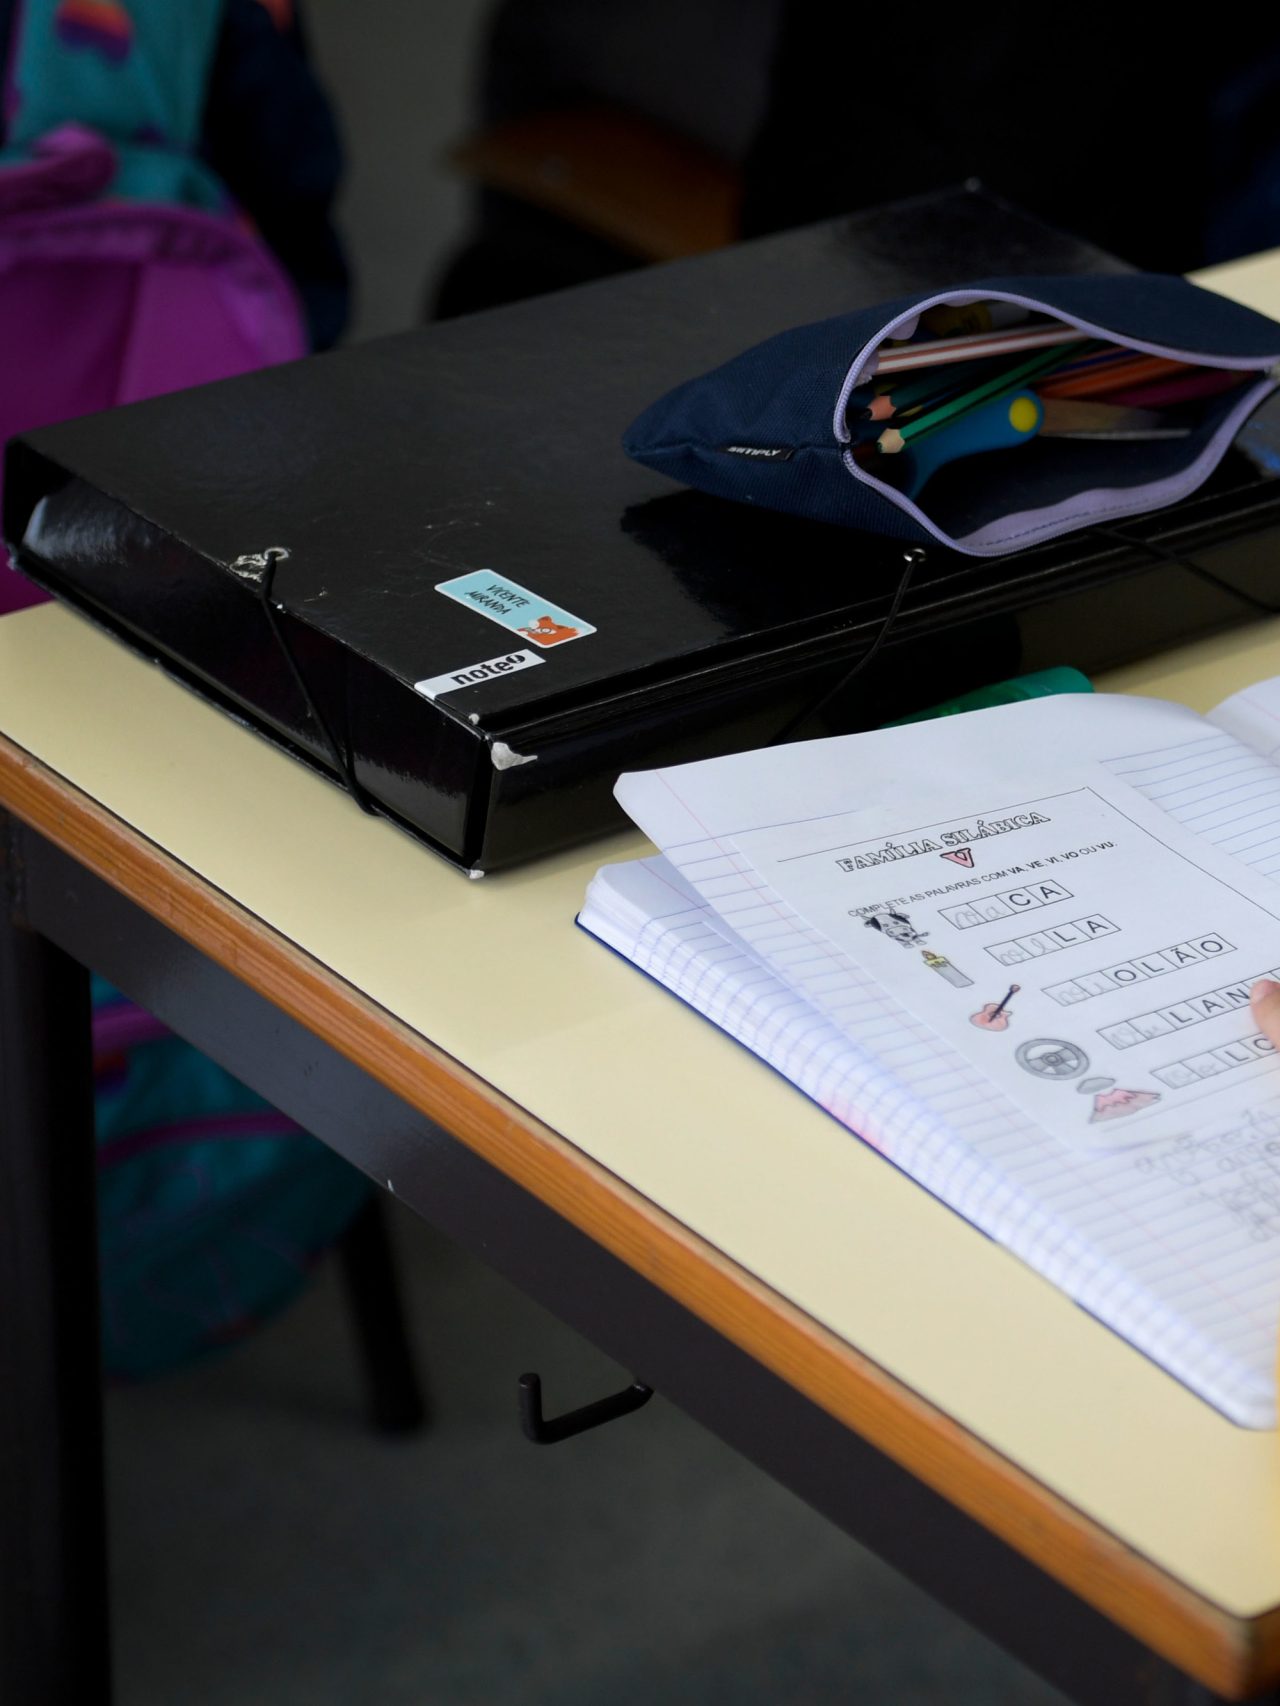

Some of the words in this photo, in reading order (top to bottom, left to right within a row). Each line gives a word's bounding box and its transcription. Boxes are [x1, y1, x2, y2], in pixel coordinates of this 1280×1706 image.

[464, 590, 512, 615] MIRANDA
[486, 584, 530, 608] VICENTE
[836, 839, 943, 873] FAMÍLIA
[940, 812, 1051, 846] SILÁBICA
[940, 847, 975, 868] V
[848, 897, 910, 917] COMPLETE
[909, 893, 926, 902] AS
[924, 878, 981, 897] PALAVRAS
[981, 870, 1008, 882] COM
[1060, 851, 1079, 860] VO
[1079, 845, 1097, 856] OU
